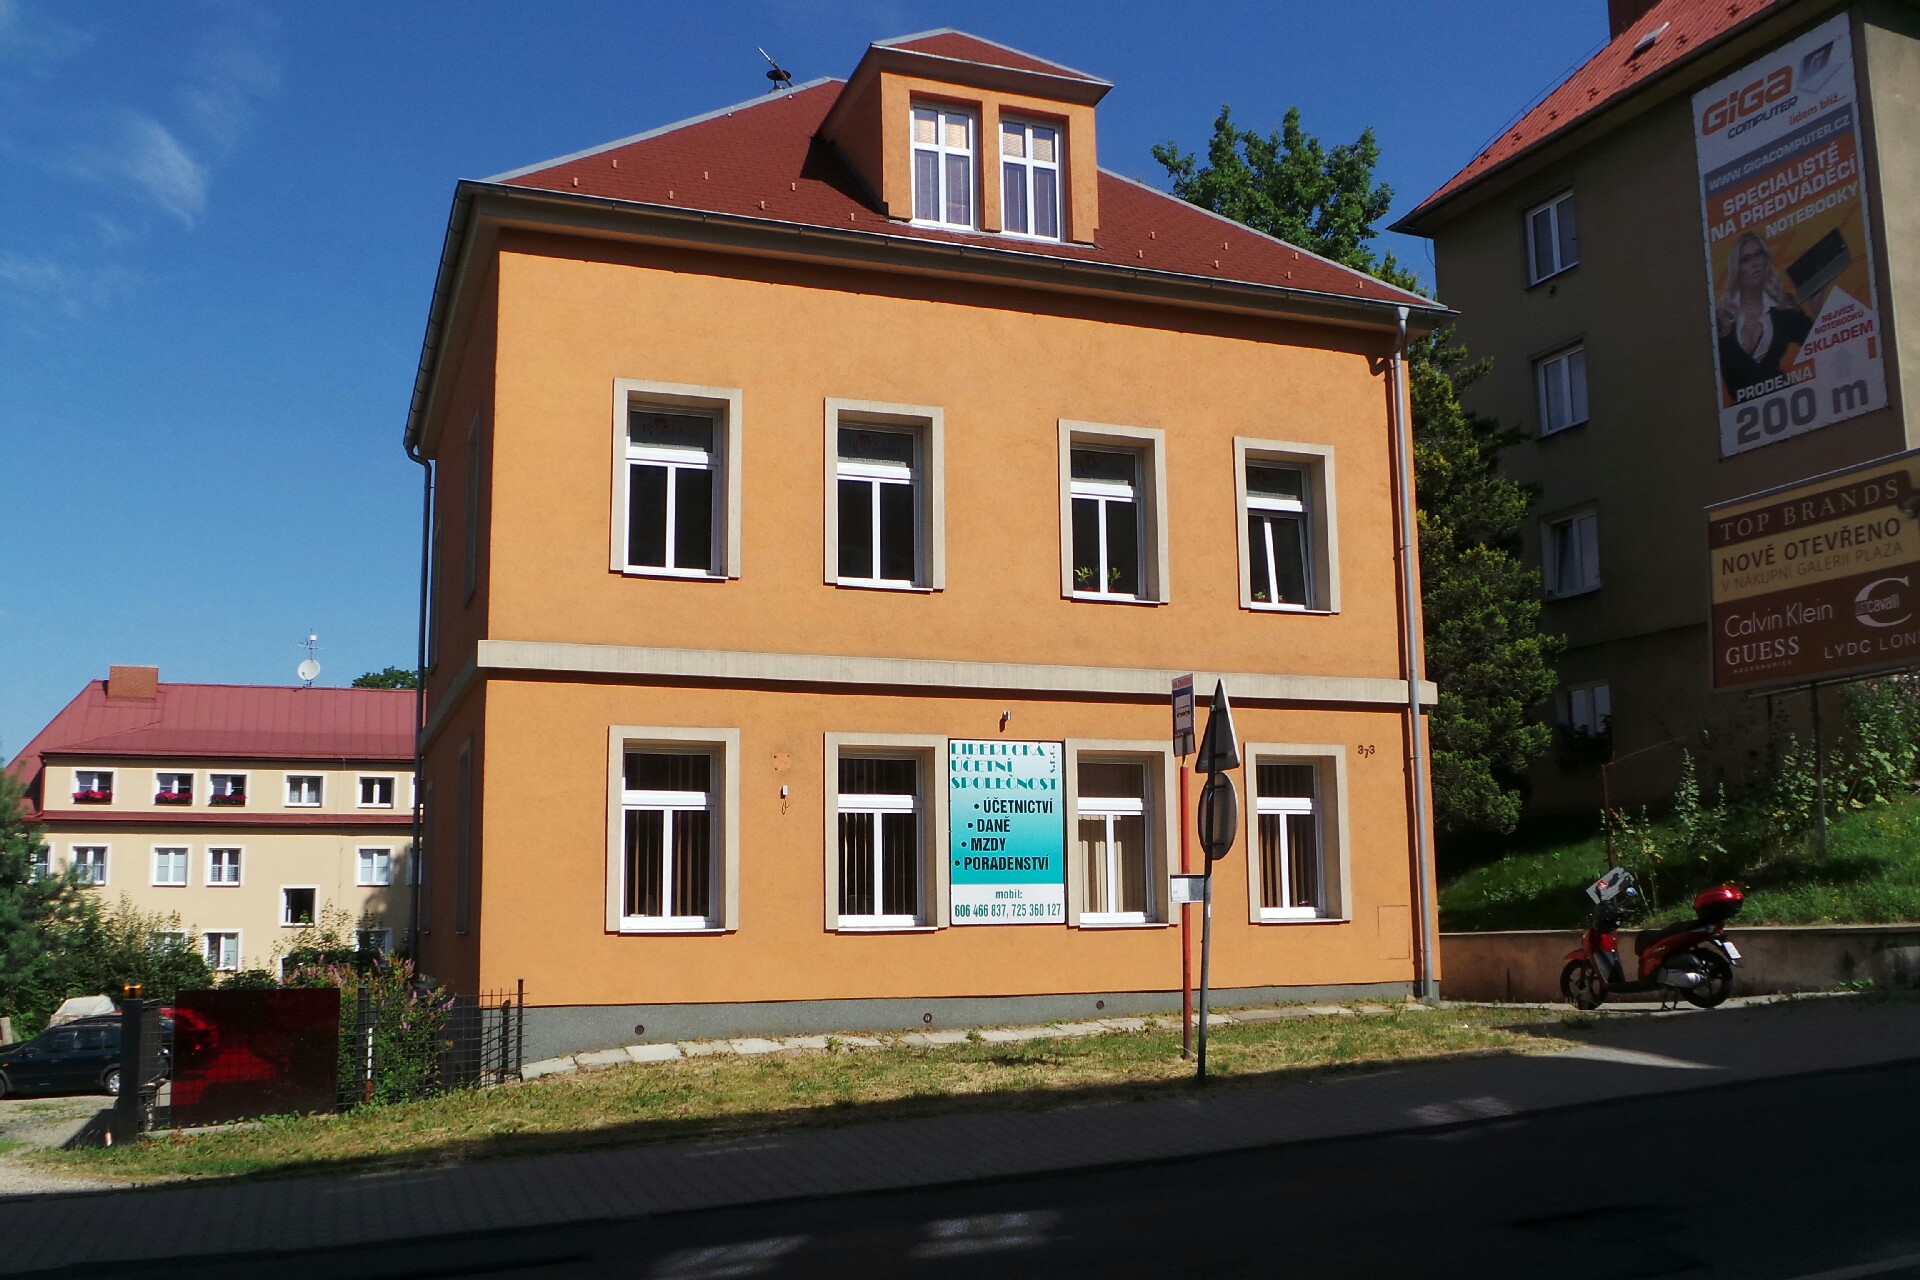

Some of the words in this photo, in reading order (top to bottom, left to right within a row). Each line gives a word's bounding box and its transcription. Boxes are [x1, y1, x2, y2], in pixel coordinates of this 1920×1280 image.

[1728, 96, 1798, 139] COMPUTER
[1789, 107, 1817, 125] lidem
[1709, 114, 1850, 191] WWW.GIGACOMPUTER.CZ
[1723, 142, 1840, 216] SPECIALISTÉ
[1711, 216, 1735, 243] NA
[1741, 153, 1857, 232] PŘEDVÁDĚCÍ
[1765, 182, 1858, 238] NOTEBOOKY
[1814, 310, 1863, 334] NOTEBOOKŮ
[1822, 304, 1855, 322] NEJVÍCE
[1804, 320, 1873, 356] SKLADEM
[1736, 367, 1812, 402] PRODEJNA
[1737, 388, 1816, 445] 200
[1832, 380, 1868, 414] m
[1720, 513, 1769, 541] TOP
[1783, 479, 1899, 525] BRANDS
[1722, 545, 1775, 575] NOVĚ
[1784, 518, 1901, 560] OTEVŘENO
[1722, 579, 1730, 592] V
[1798, 554, 1850, 576] GALERII
[1856, 542, 1903, 564] PLAZA
[1725, 608, 1782, 637] Calvin
[1786, 598, 1833, 627] Klein
[1726, 636, 1799, 665] GUESS
[1825, 640, 1870, 659] LYDC
[1880, 631, 1920, 650] LON
[952, 742, 1045, 756] LIBERECKÁ
[1358, 745, 1375, 759] 373
[952, 757, 1013, 772] ÚČETNÍ
[952, 774, 1058, 790] SPOLEČNOST
[984, 796, 1053, 814] ÚČETNICTVÍ
[977, 816, 1010, 832] DANĚ
[970, 838, 1006, 851] MZDY
[964, 854, 1049, 870] PORADENSTVÍ
[996, 889, 1023, 899] mobil:
[955, 904, 970, 917] 606
[973, 904, 988, 917] 466
[992, 904, 1008, 918] 837,
[1011, 904, 1026, 917] 725
[1029, 904, 1044, 917] 360
[1047, 903, 1061, 916] 127
